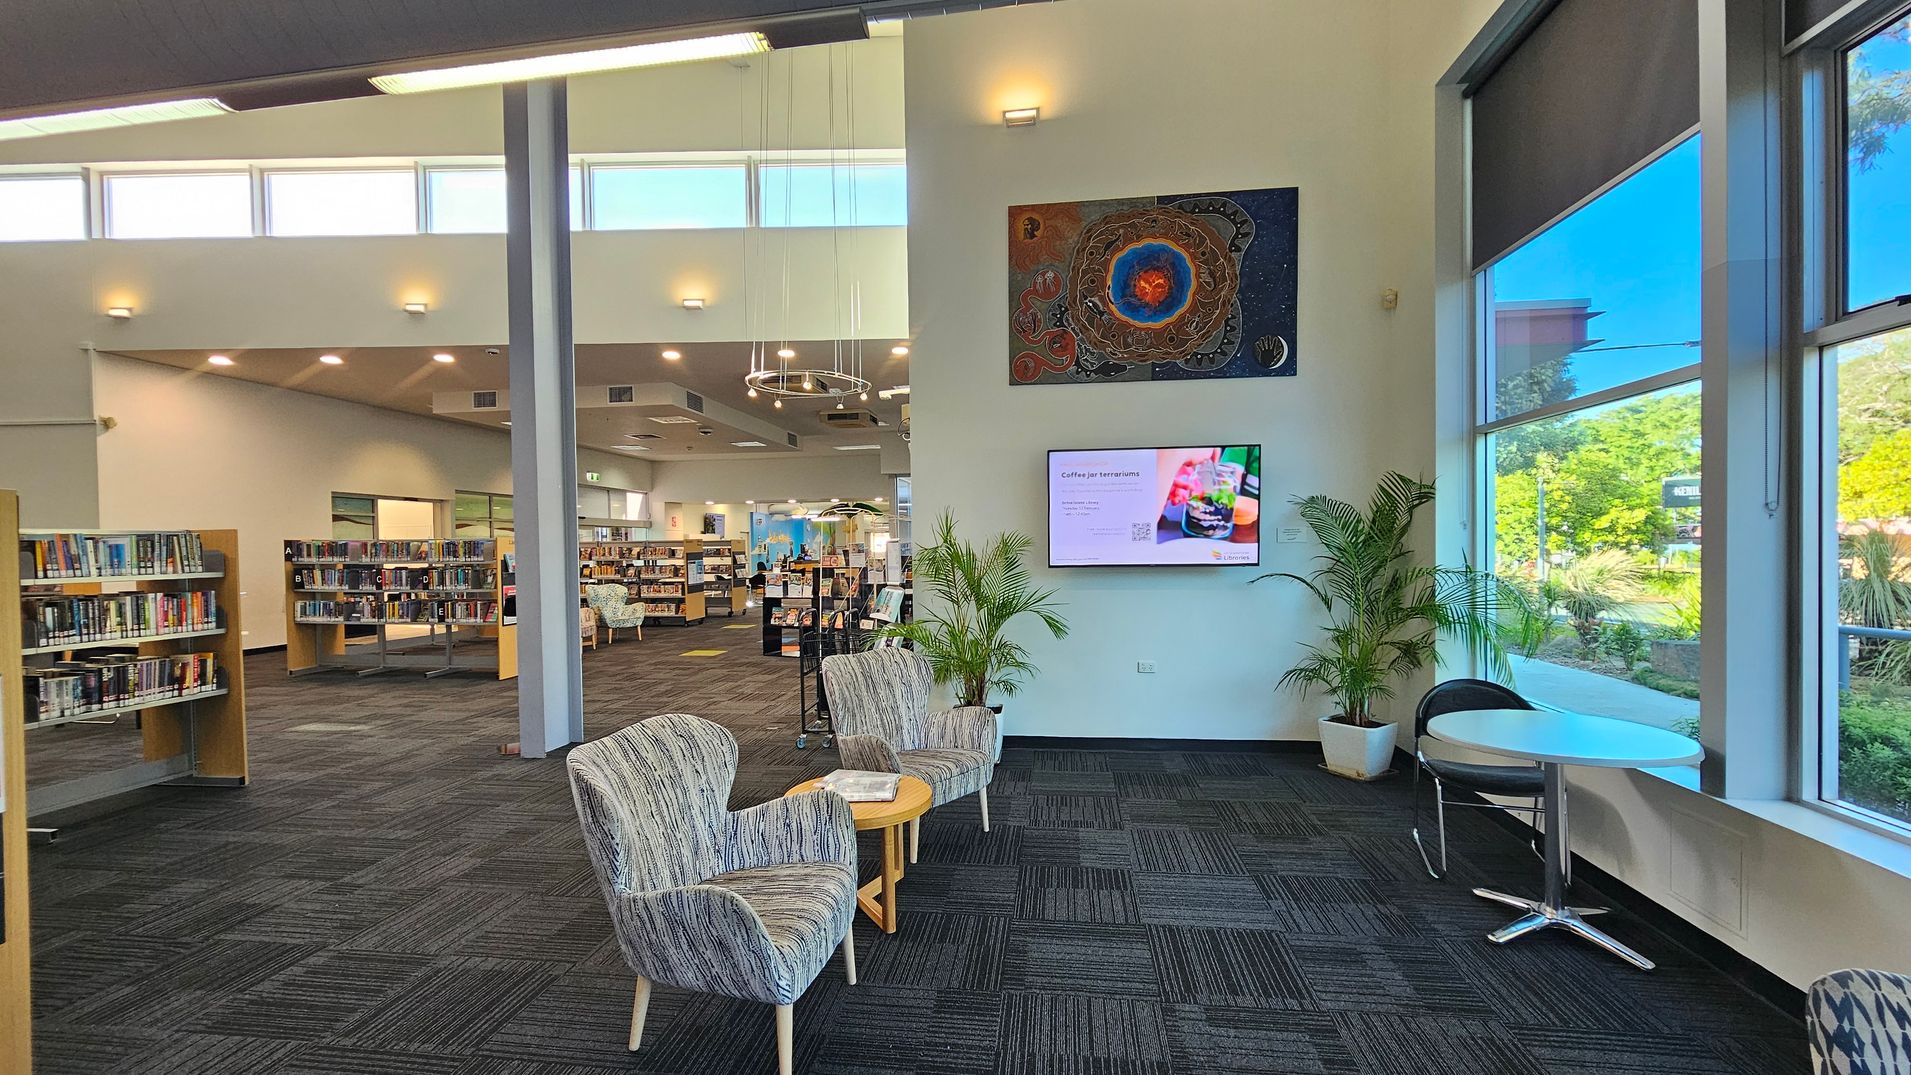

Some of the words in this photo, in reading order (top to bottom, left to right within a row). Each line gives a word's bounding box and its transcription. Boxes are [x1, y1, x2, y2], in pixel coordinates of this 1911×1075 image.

[1087, 471, 1098, 479] jar
[1100, 470, 1140, 478] terrariums
[285, 547, 292, 555] A
[295, 575, 302, 583] B
[376, 575, 382, 583] C
[423, 575, 429, 583] D
[438, 607, 444, 616] E
